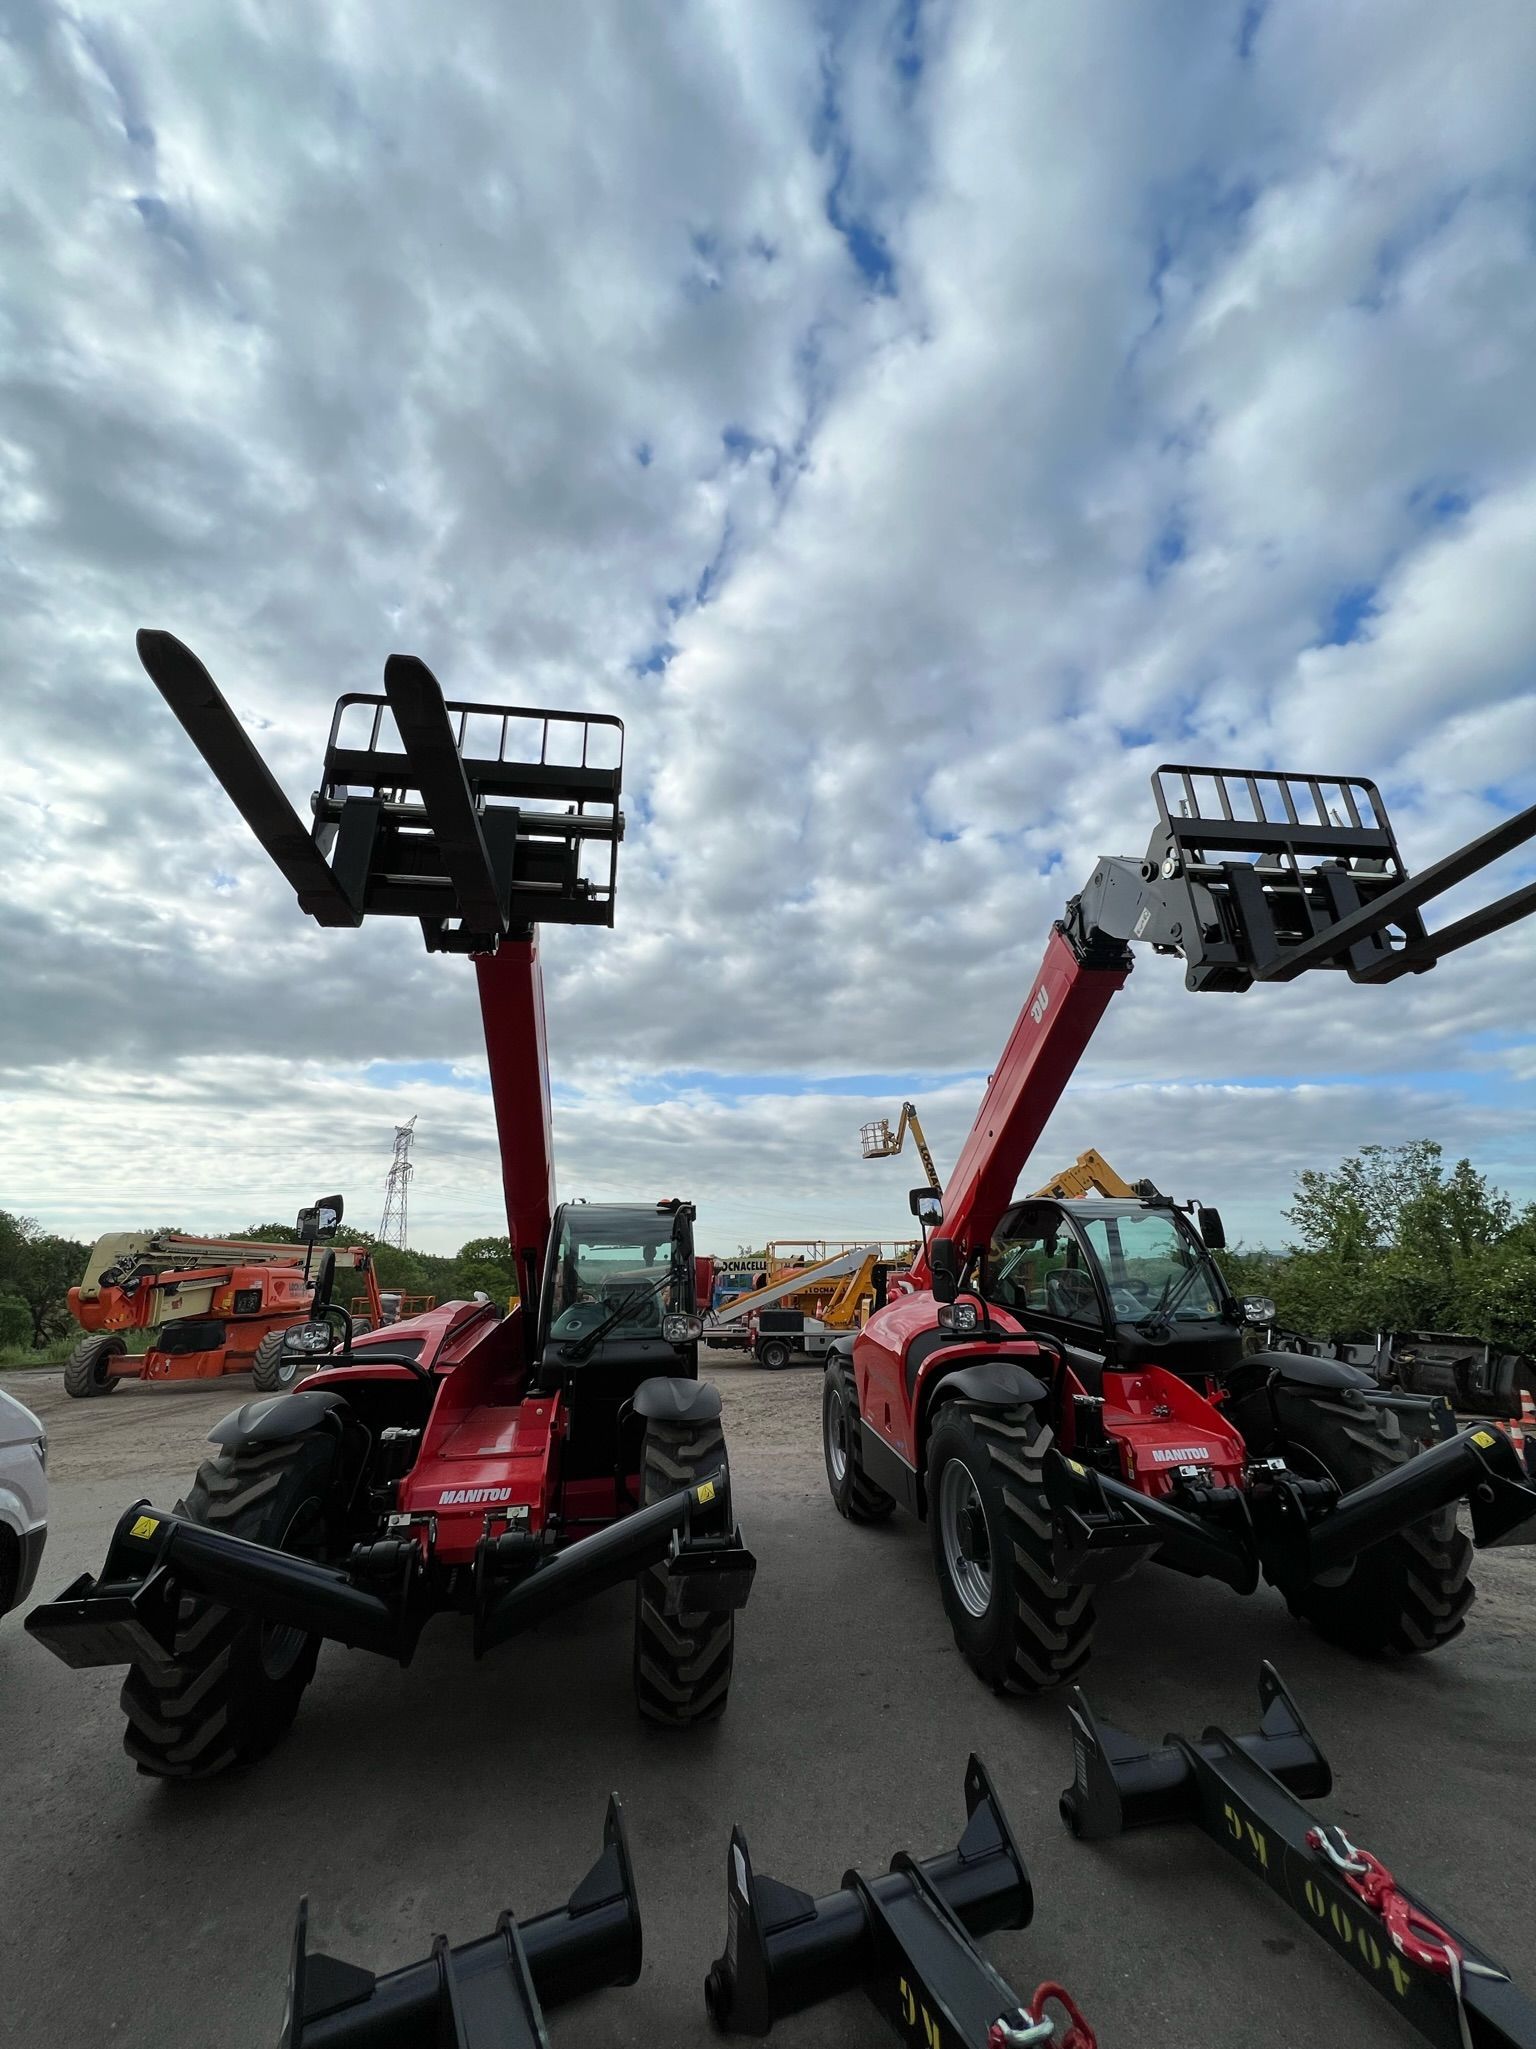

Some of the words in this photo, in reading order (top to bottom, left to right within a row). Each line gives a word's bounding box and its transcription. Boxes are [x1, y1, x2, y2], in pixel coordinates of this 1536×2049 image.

[721, 1261, 768, 1273] OCNACELLE
[1152, 1447, 1209, 1462] MANITOU
[438, 1487, 512, 1505] MANITOU
[1224, 1803, 1269, 1869] KG
